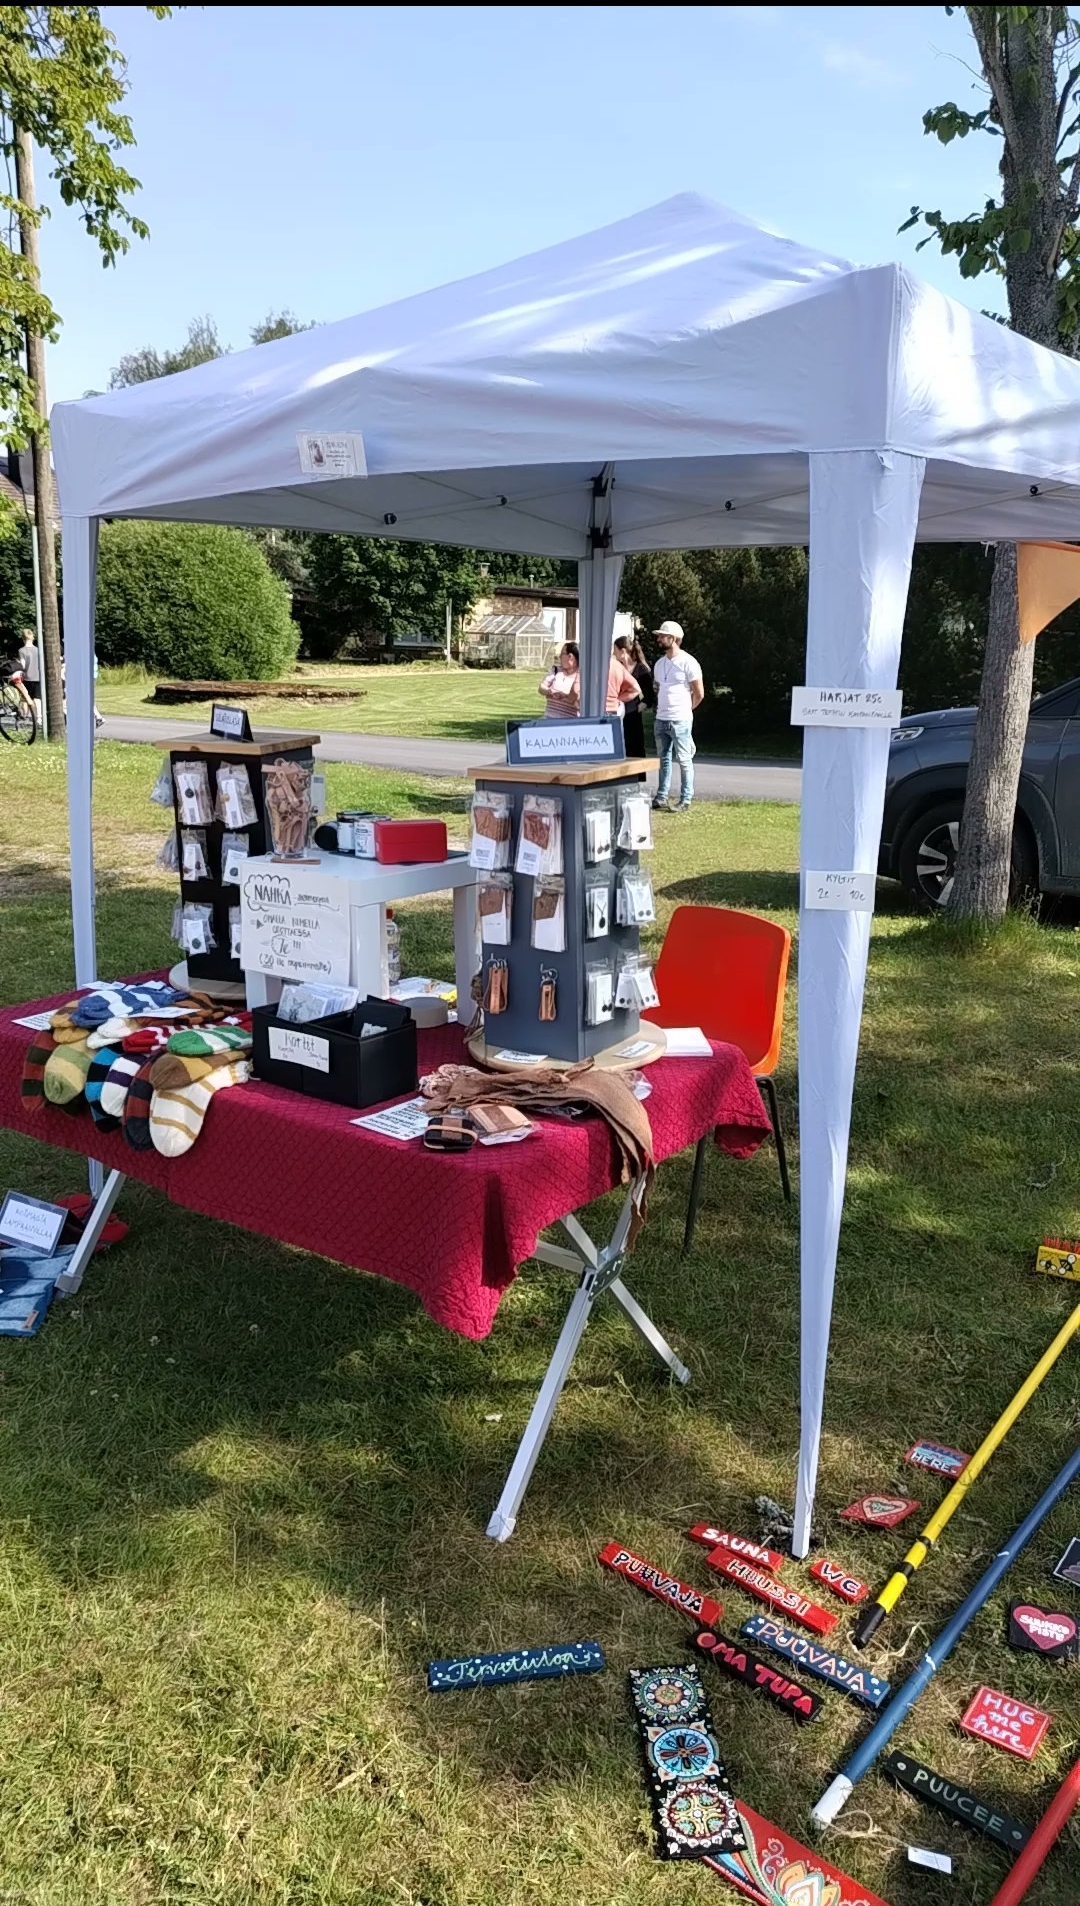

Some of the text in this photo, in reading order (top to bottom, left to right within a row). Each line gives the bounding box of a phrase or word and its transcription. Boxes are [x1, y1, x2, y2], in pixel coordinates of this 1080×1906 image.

[525, 736, 609, 750] KALANNAHKAA
[254, 883, 292, 906] NAHKA
[701, 1527, 770, 1562] SAUNA
[613, 1551, 704, 1615] PUUVAJA
[727, 1559, 812, 1616] HUUSSI
[820, 1561, 862, 1596] WC
[1029, 1624, 1065, 1642] PISTE
[442, 1650, 591, 1682] Tervetuloa
[696, 1632, 813, 1715] OMA TUPA
[755, 1622, 866, 1692] PUUVAJA
[983, 1693, 1036, 1726] HUG
[988, 1710, 1022, 1732] me
[912, 1768, 1005, 1833] PUUCEE
